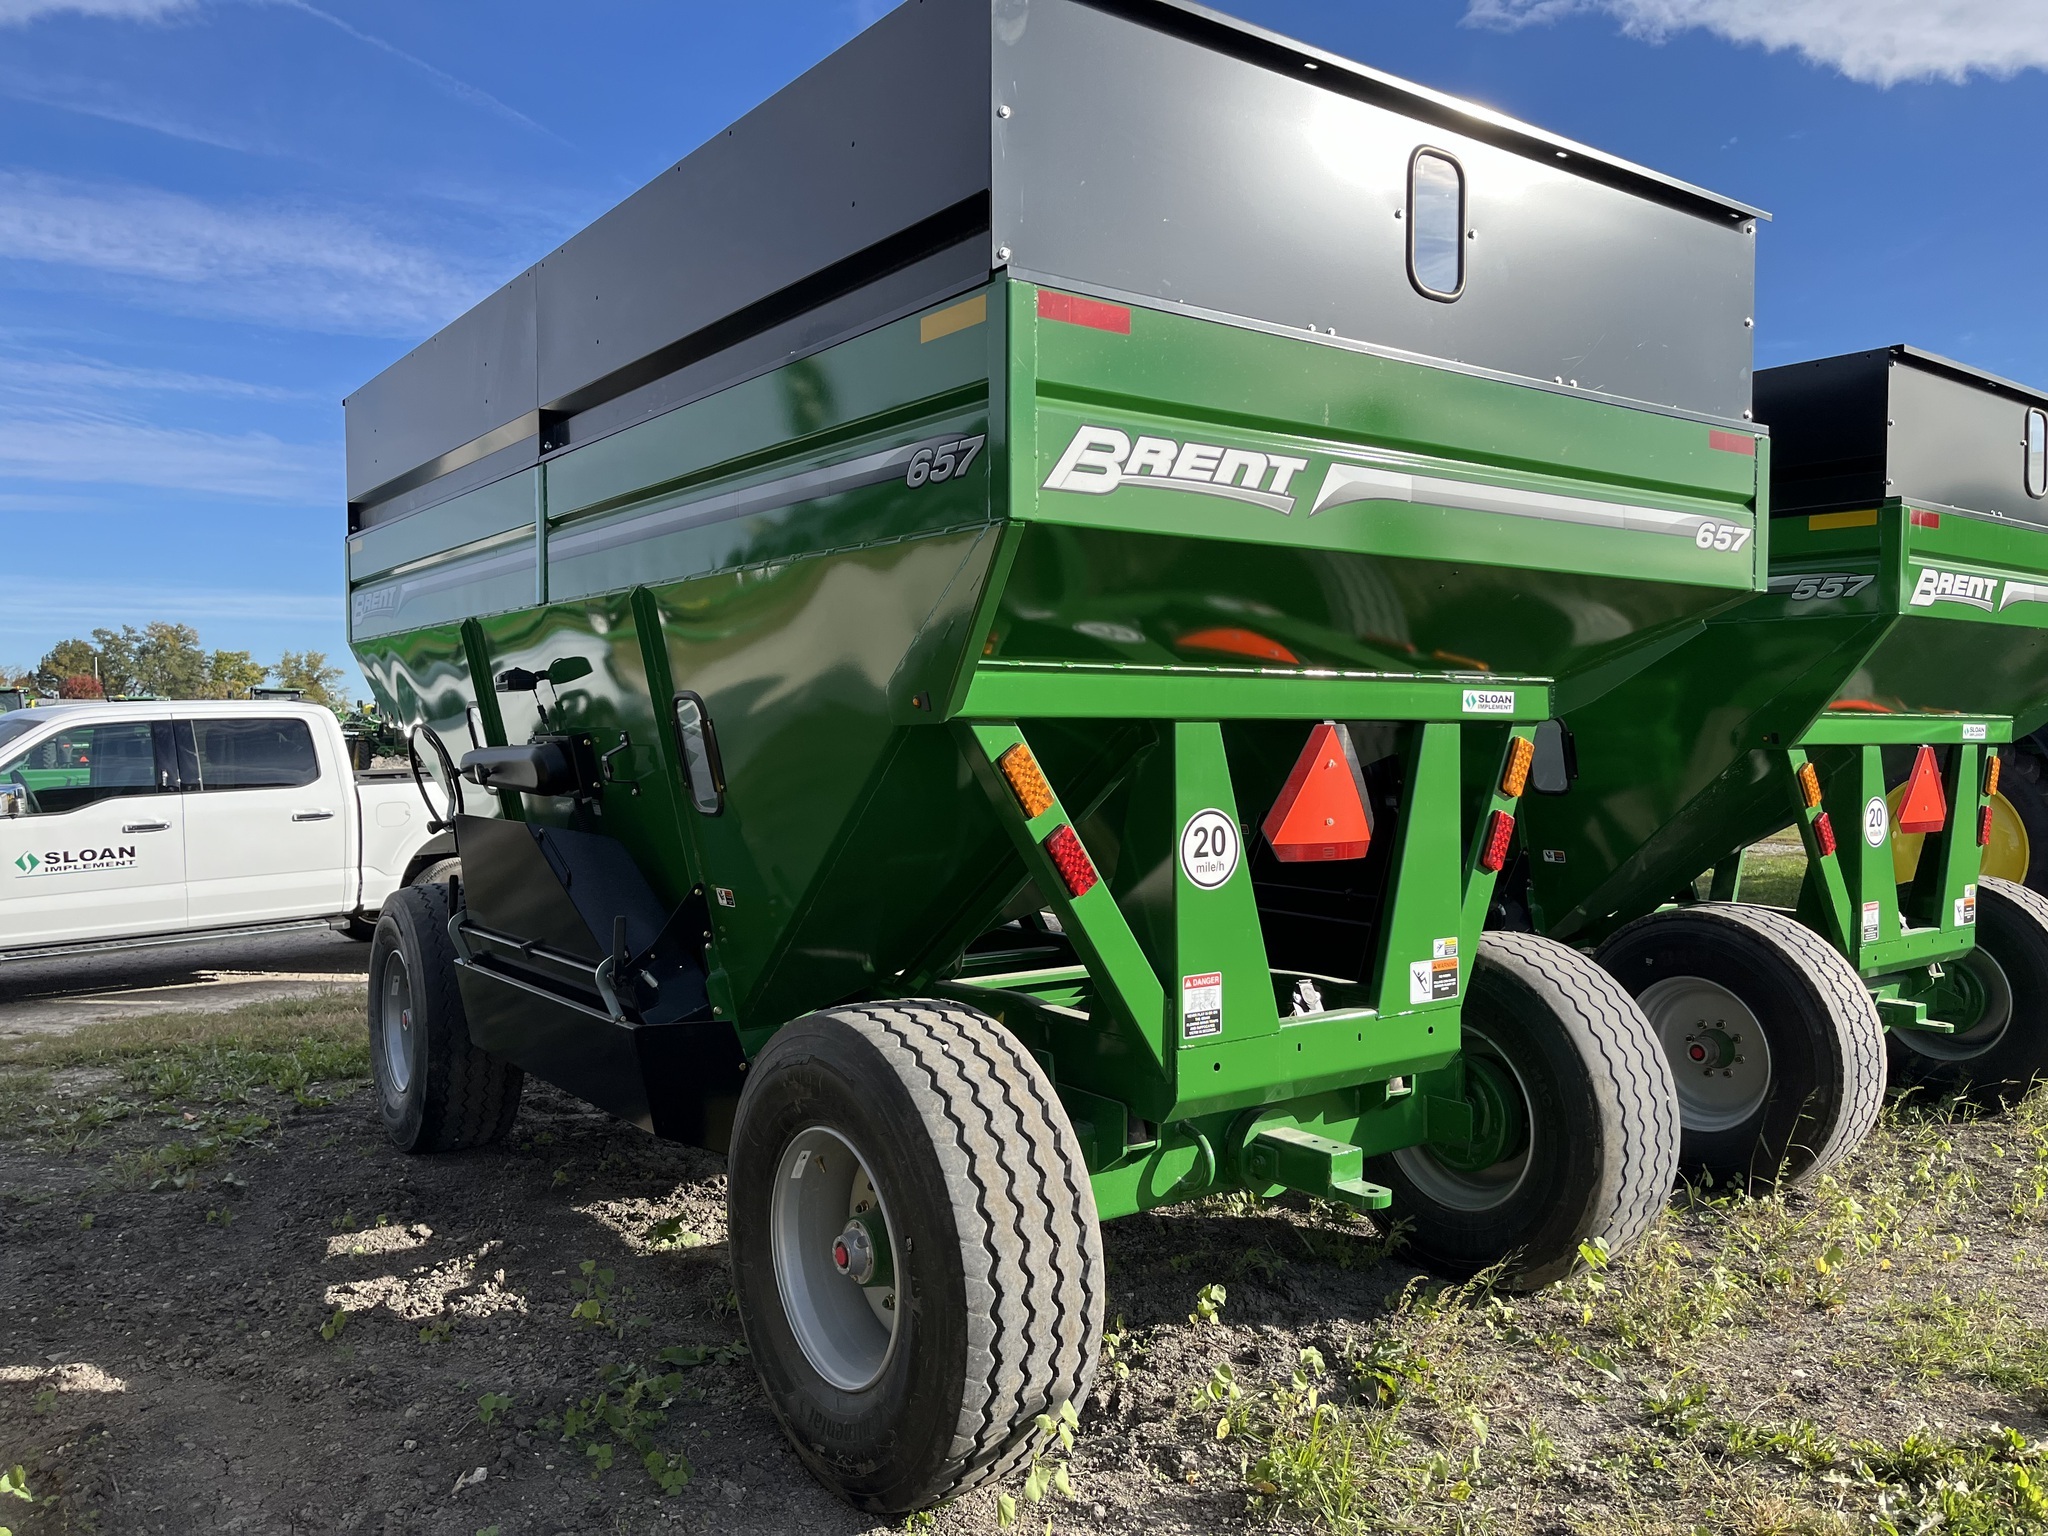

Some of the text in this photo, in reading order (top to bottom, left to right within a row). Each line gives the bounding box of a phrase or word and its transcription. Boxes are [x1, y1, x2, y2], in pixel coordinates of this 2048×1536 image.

[906, 433, 987, 490] 657
[1040, 425, 1310, 495] BRENT
[1695, 521, 1753, 552] 657
[1791, 573, 1877, 601] 557
[1909, 567, 1998, 607] BRENT
[351, 585, 398, 627] BRENT
[1477, 694, 1512, 704] SLOAN
[1869, 807, 1883, 828] 20
[44, 846, 136, 865] SLOAN
[1193, 825, 1226, 859] 20
[44, 859, 136, 873] IMPLEMENT
[1196, 860, 1225, 874] mile/h
[1192, 975, 1220, 987] DANGER
